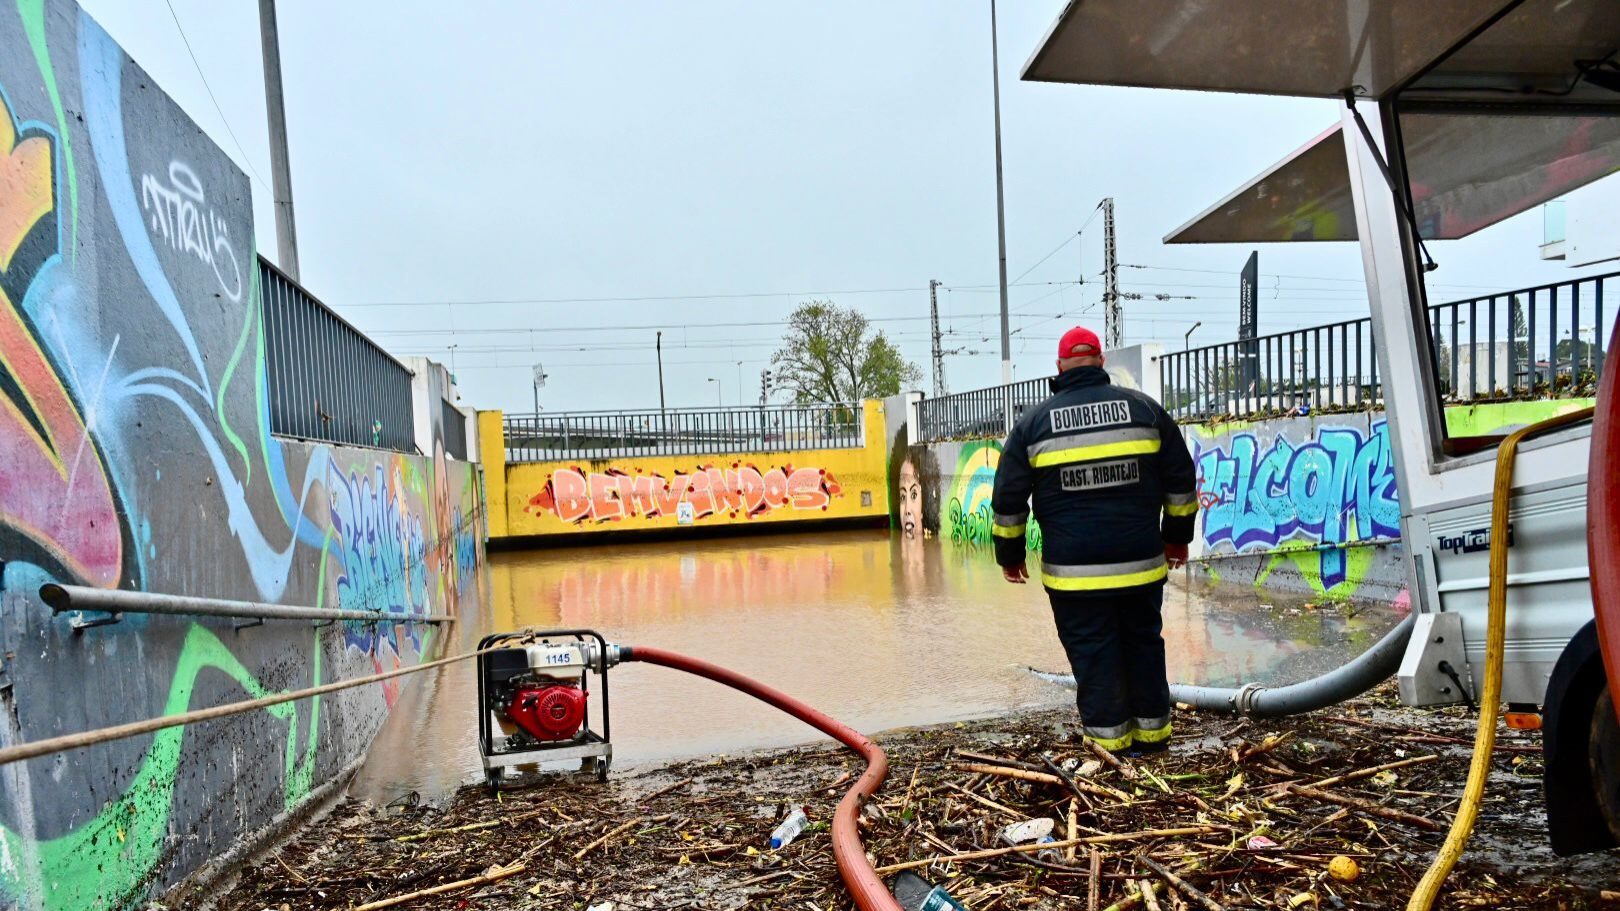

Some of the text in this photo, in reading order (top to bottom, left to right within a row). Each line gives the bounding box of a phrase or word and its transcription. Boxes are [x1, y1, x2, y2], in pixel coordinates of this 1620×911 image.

[1053, 402, 1128, 430] BOMBEIROS
[1062, 461, 1138, 488] CAST. RIBATEJO
[1437, 524, 1514, 555] TopTrai
[545, 652, 571, 664] 1145
